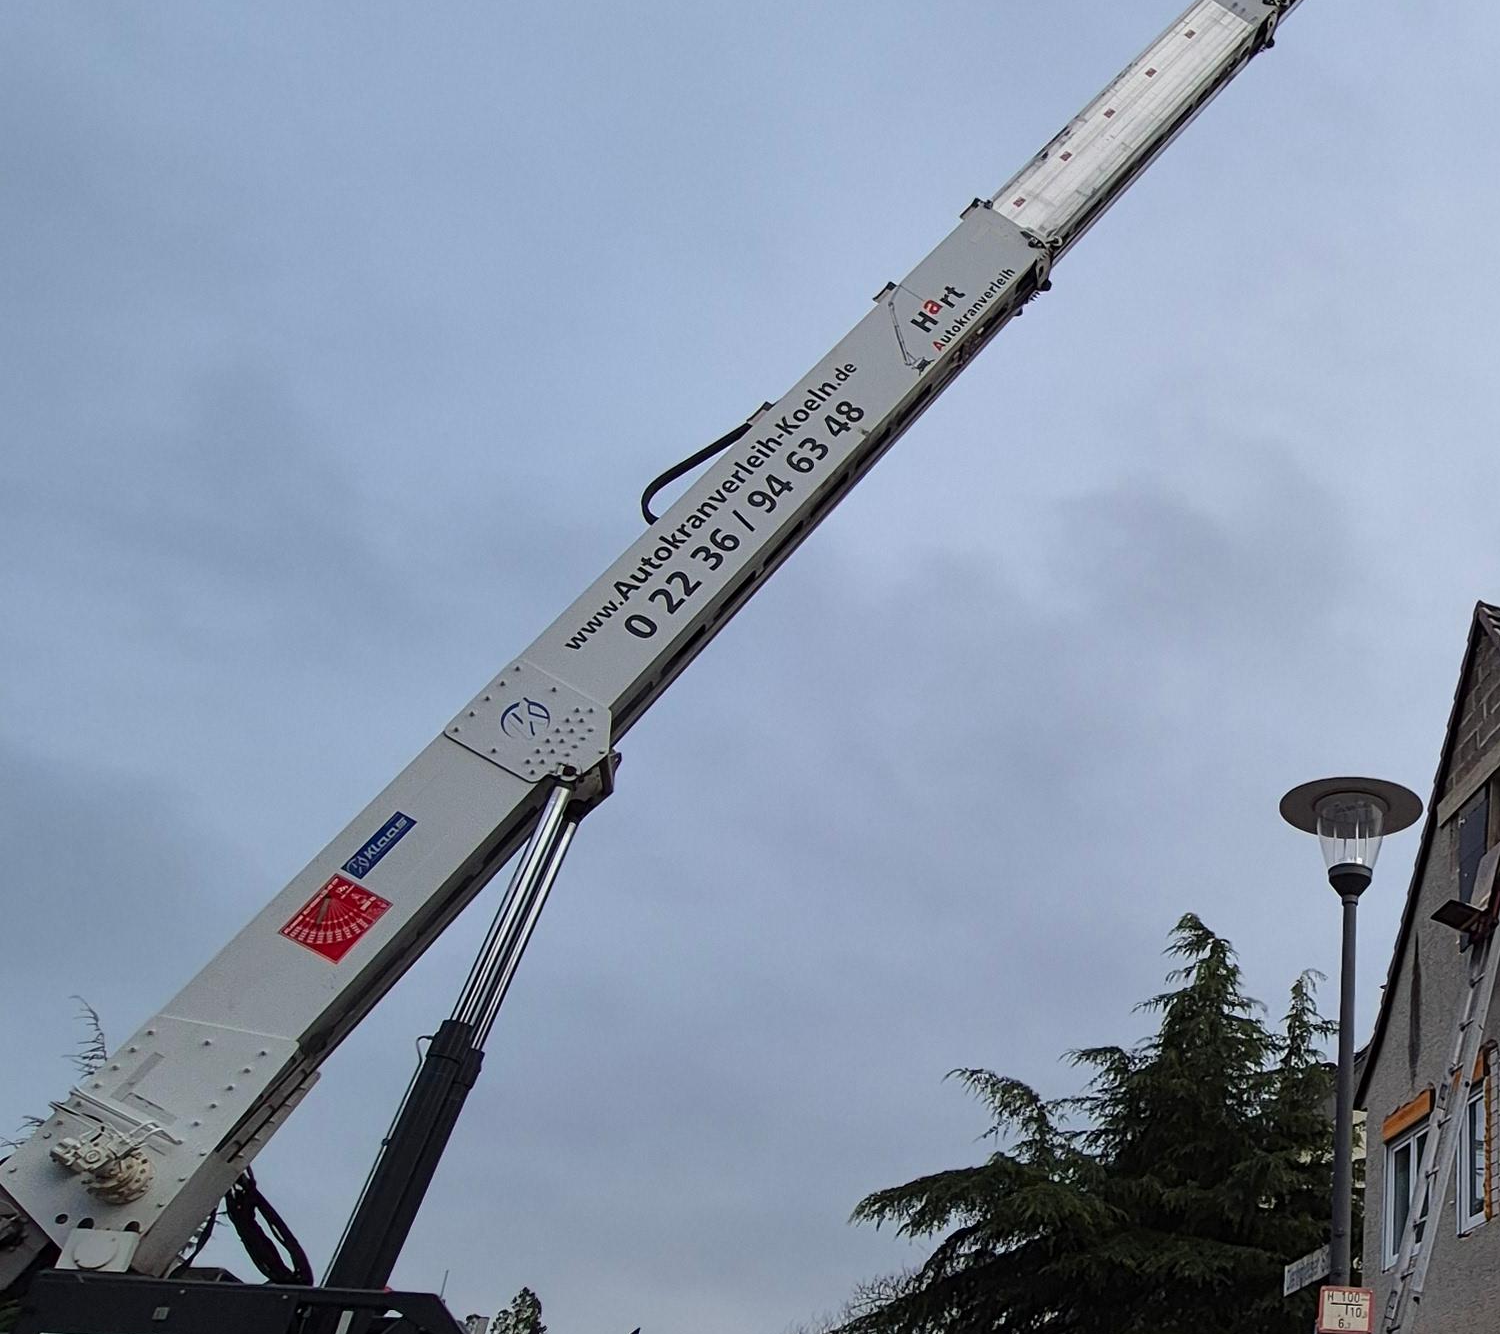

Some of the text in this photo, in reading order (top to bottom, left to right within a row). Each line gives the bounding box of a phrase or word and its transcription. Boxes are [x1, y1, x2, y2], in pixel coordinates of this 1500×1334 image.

[910, 286, 966, 333] Hart
[932, 267, 1015, 351] Autokranverleih
[565, 361, 857, 652] www.Autokranverleih-Koeln.de
[624, 401, 864, 639] 0 22 36 / 94 63 48
[1327, 1291, 1360, 1303] H 100
